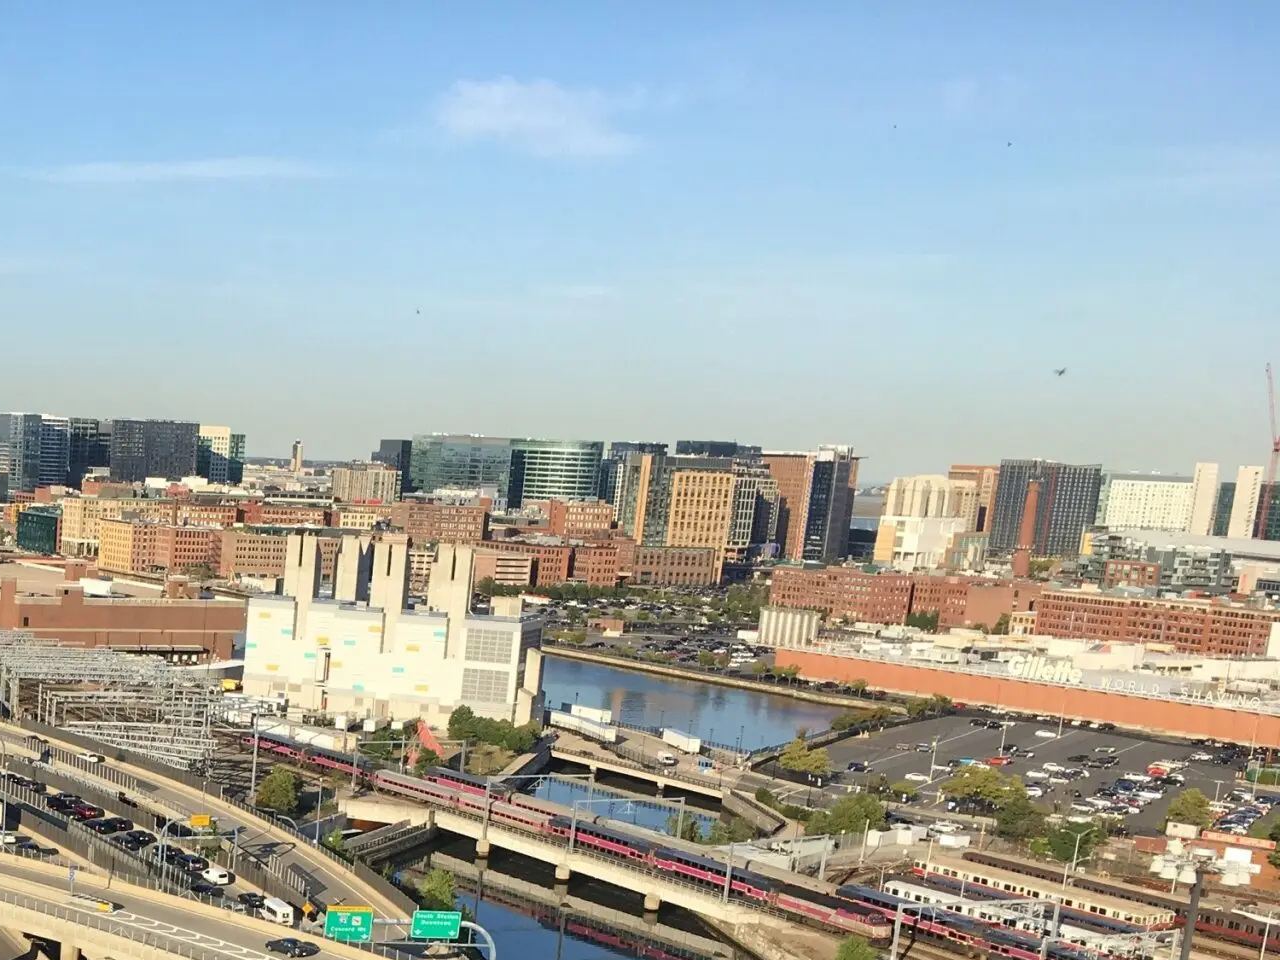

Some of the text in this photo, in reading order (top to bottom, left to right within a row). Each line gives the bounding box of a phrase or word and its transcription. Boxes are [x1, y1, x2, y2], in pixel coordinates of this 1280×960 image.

[1008, 654, 1082, 683] Gillette
[1101, 676, 1261, 708] WORLD SHAVING
